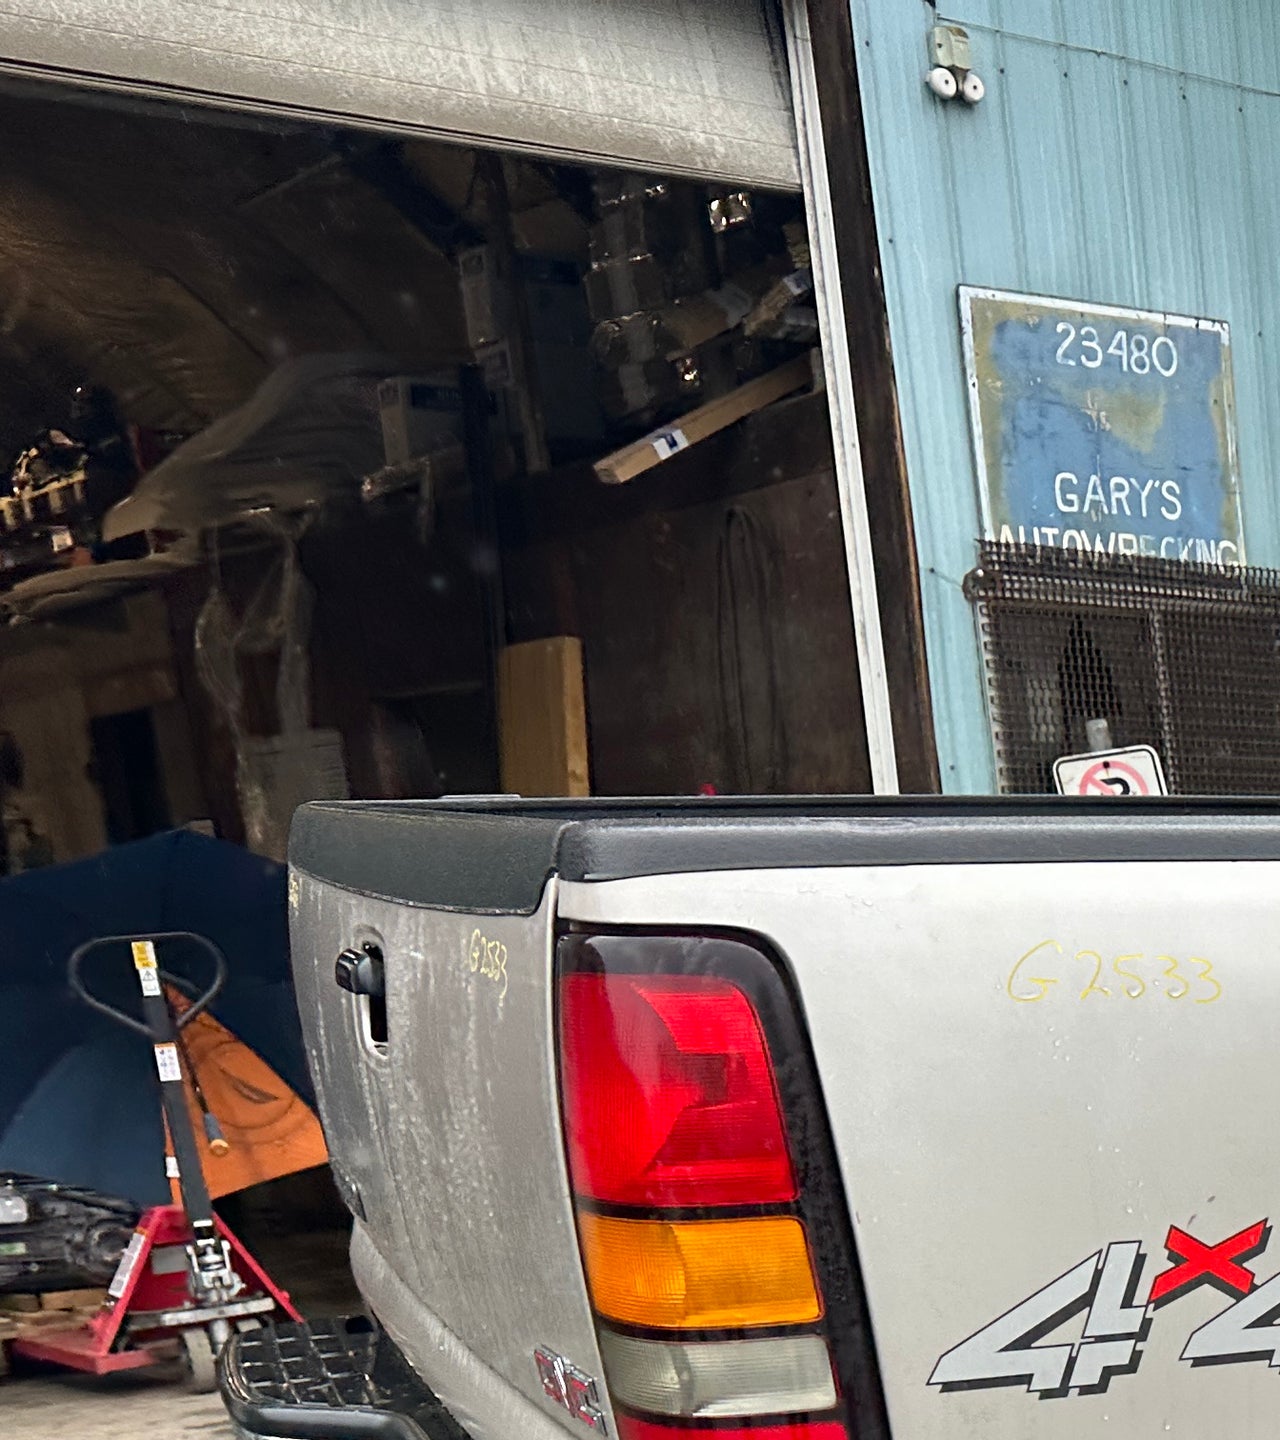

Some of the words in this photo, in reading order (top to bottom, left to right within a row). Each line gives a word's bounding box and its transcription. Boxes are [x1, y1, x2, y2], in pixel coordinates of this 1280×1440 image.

[1056, 322, 1178, 377] 23480
[1054, 472, 1183, 521] GARY'S
[469, 928, 508, 1007] G2533
[1007, 939, 1222, 1004] G2533
